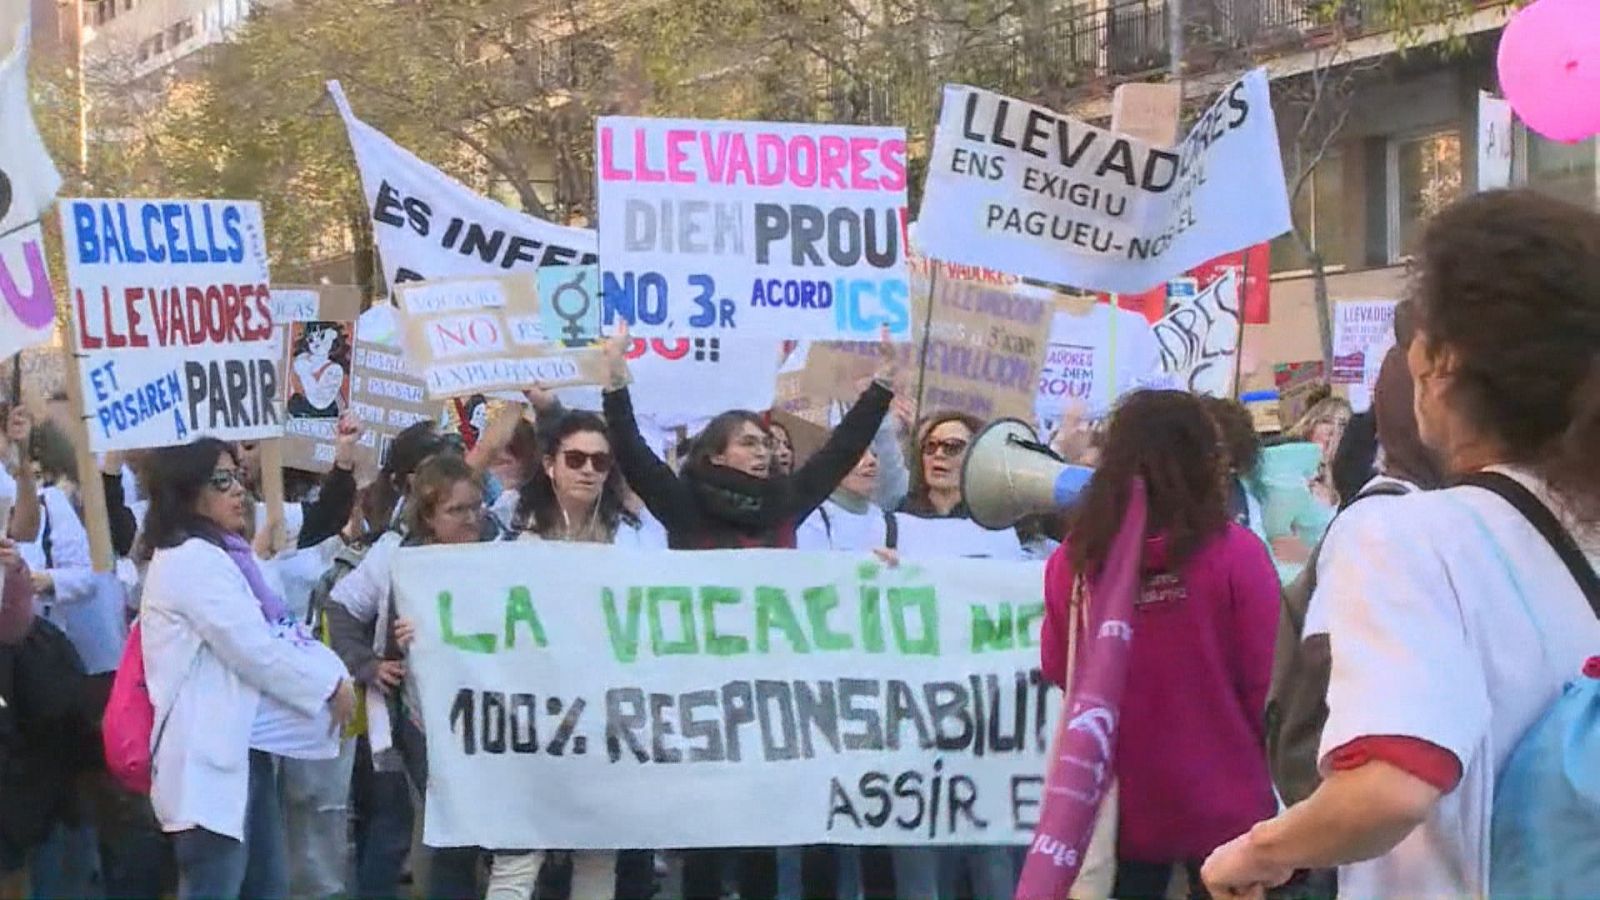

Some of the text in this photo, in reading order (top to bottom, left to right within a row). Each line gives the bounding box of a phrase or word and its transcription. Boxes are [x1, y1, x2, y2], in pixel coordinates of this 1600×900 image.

[601, 127, 908, 192] LLEVADORES
[951, 148, 1005, 181] ENS
[1023, 166, 1127, 217] EXIGIU
[72, 202, 245, 264] BALCELLS
[441, 217, 598, 269] INFE
[625, 199, 909, 268] DIEM PROU!
[75, 284, 274, 349] LLEVADORES
[434, 319, 499, 352] NO
[751, 278, 833, 309] ACORD
[834, 278, 909, 334] ICS
[90, 361, 117, 400] ET
[98, 372, 183, 439] POSAREM
[184, 360, 280, 430] PARIR
[437, 585, 549, 654] LA
[450, 688, 587, 757] 100%
